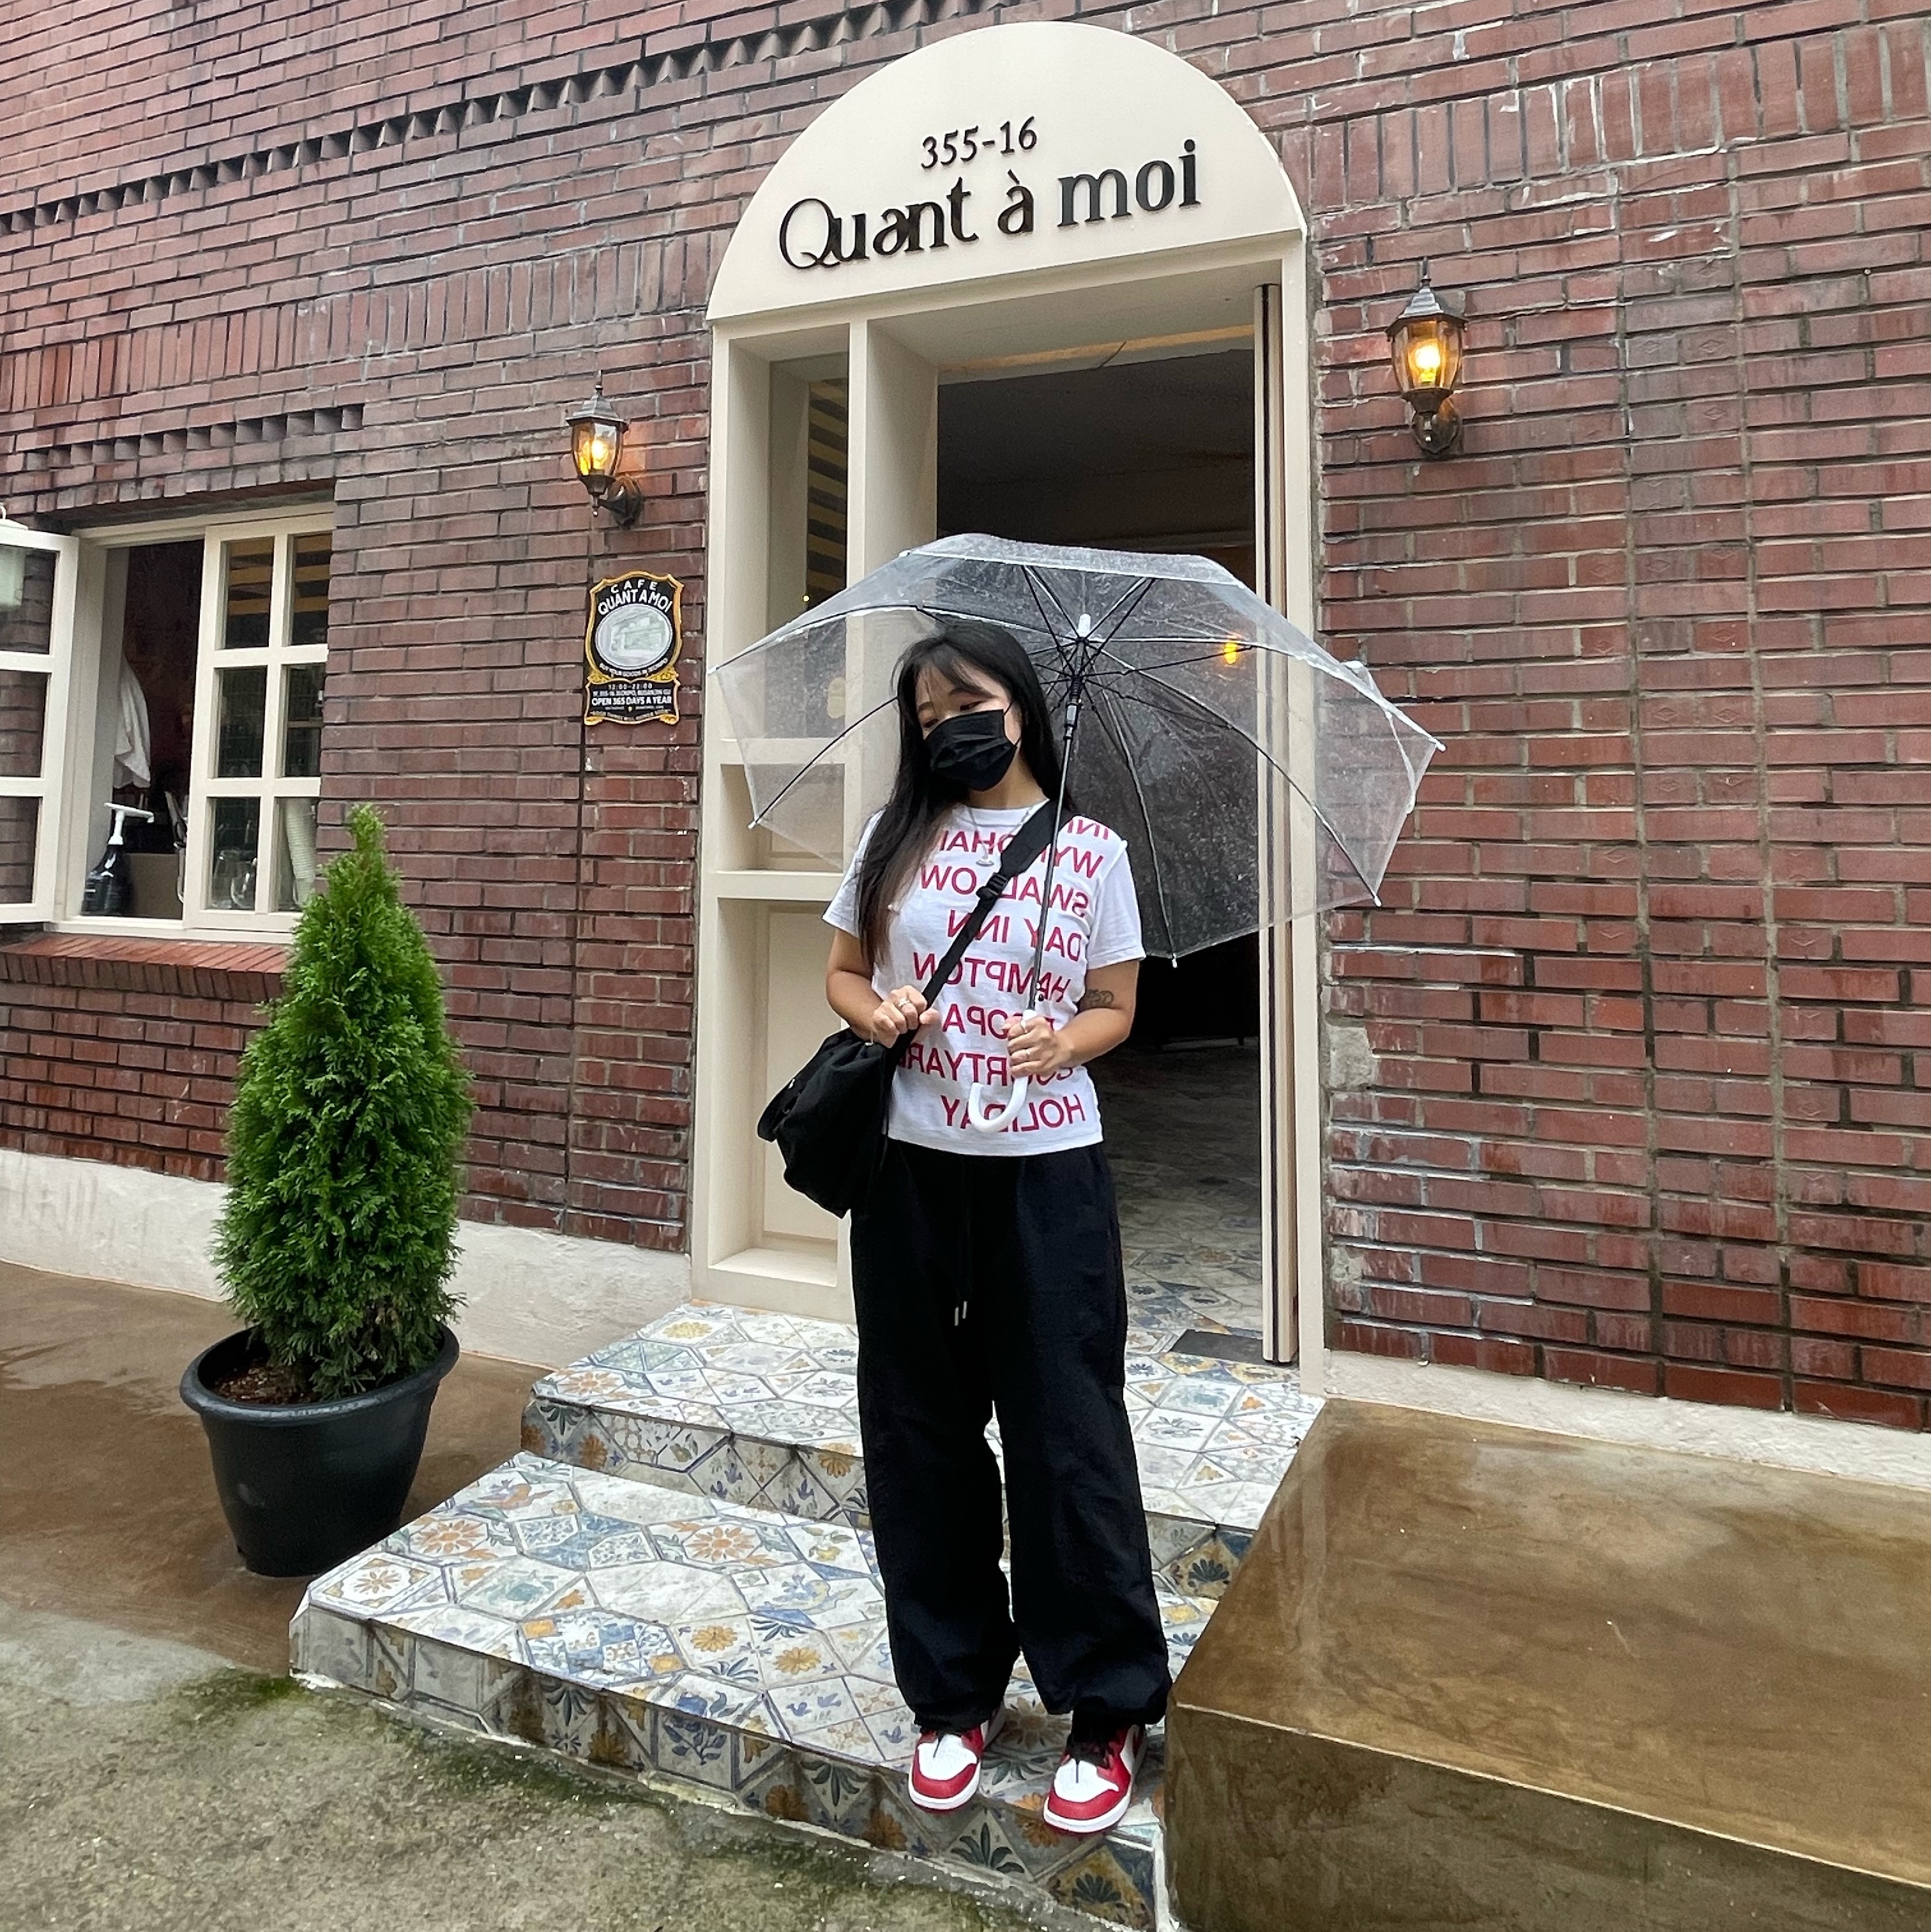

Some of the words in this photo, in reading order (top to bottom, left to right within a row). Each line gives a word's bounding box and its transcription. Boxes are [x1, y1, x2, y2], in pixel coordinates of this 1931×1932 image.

[921, 116, 1038, 170] 355-16
[779, 176, 979, 271] Quant
[997, 169, 1034, 235] à
[1057, 139, 1201, 229] moi
[610, 579, 658, 594] CAFE
[591, 697, 612, 706] OPEN
[626, 696, 645, 704] DAYS
[653, 696, 672, 704] YEAR
